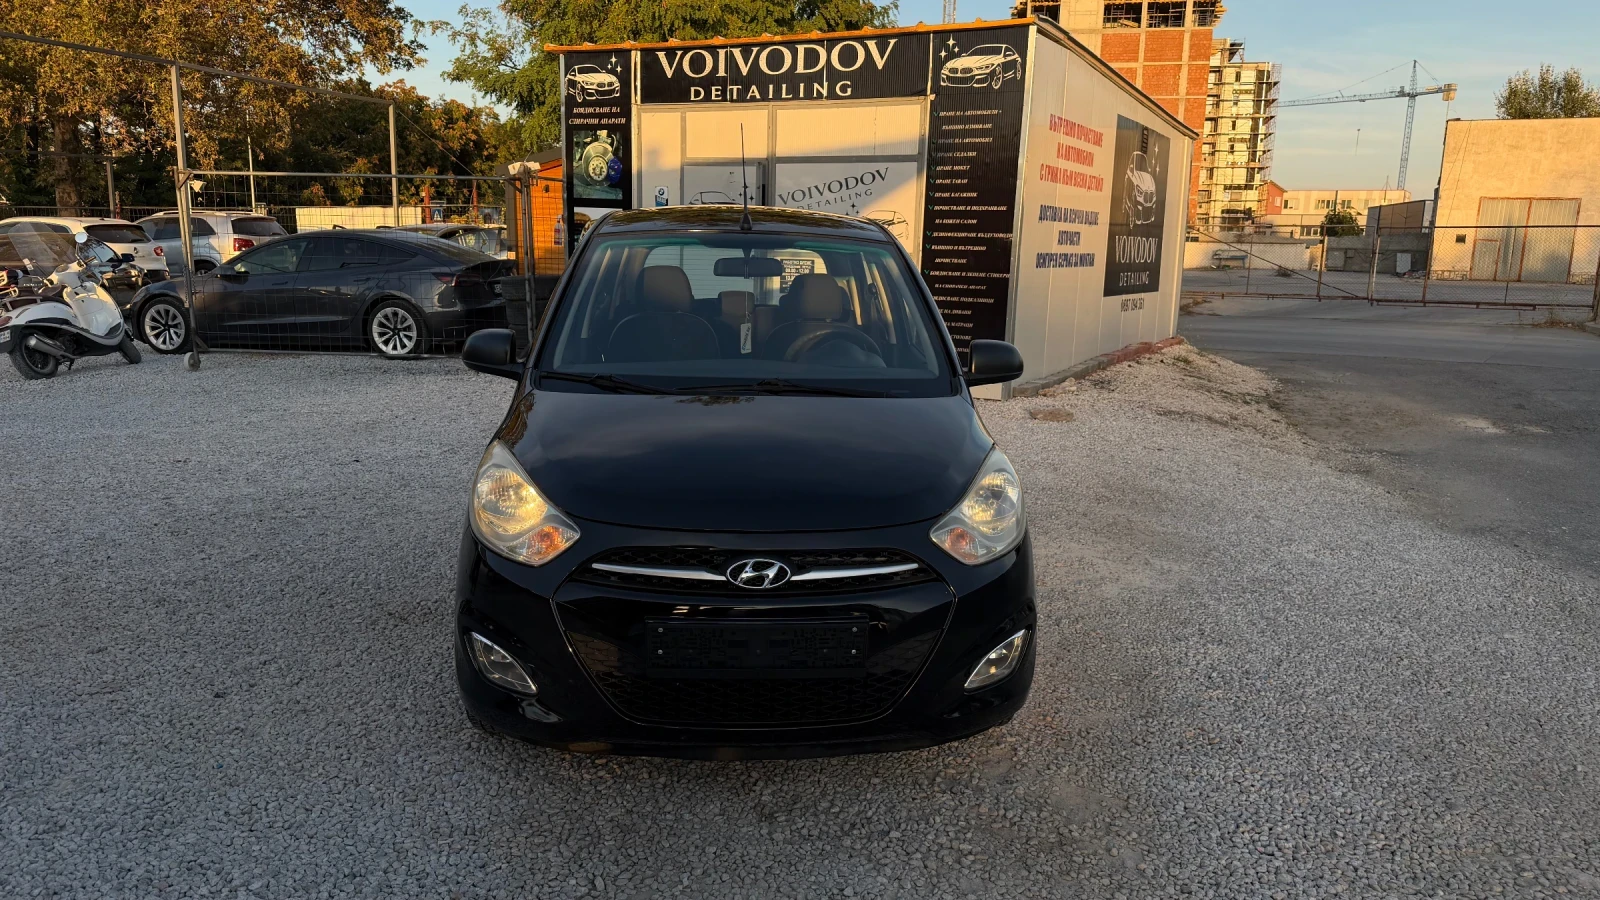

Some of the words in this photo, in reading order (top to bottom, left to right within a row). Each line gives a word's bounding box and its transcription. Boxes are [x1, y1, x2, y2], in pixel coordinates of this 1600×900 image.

[656, 39, 897, 79] VOIVODOV
[690, 81, 853, 101] DETAILING
[1057, 142, 1064, 160] НА
[1040, 163, 1044, 181] С
[778, 167, 889, 205] VOIVODOV
[1115, 235, 1158, 263] VOIVODOV
[1119, 271, 1150, 286] DETAILING
